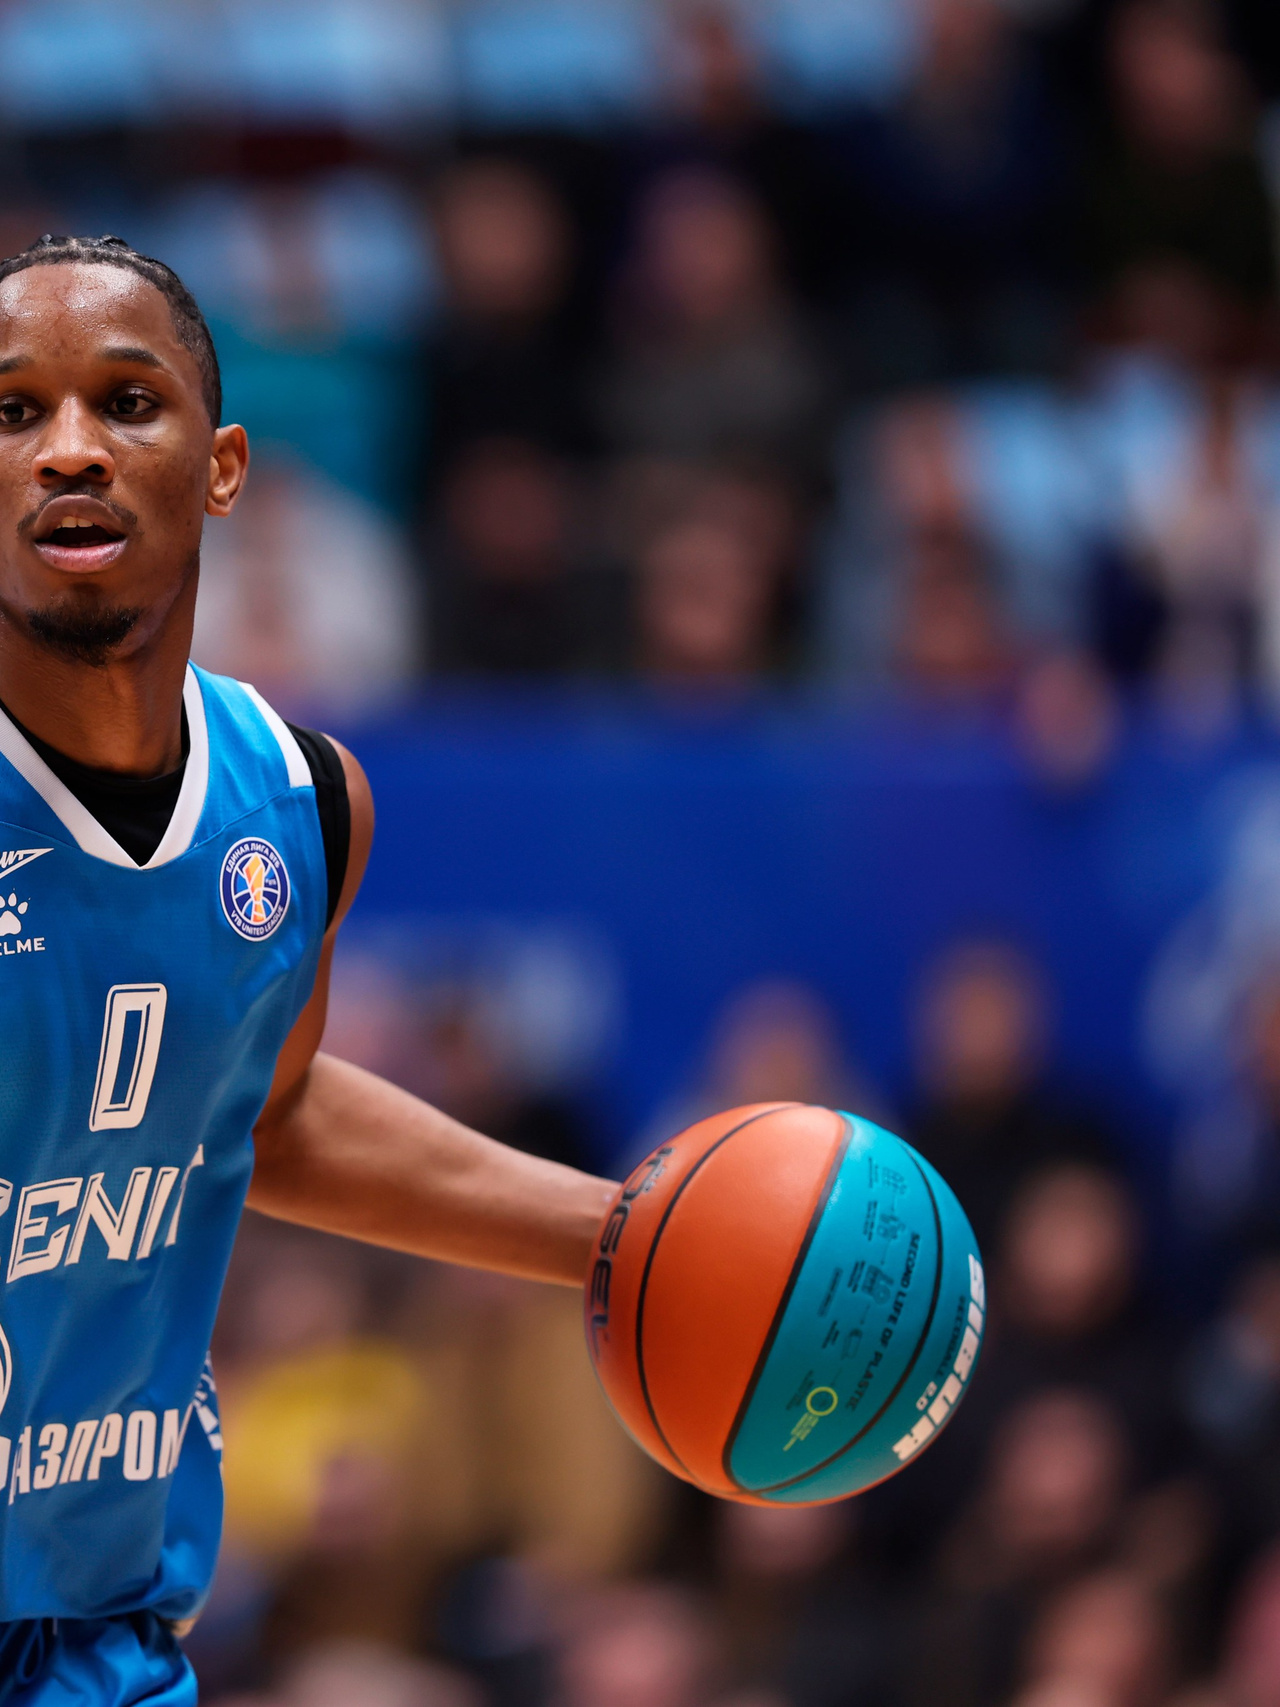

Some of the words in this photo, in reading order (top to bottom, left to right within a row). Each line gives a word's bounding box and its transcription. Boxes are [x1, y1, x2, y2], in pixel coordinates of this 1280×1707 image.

[225, 843, 250, 874] ЕДИНАЯ
[250, 843, 270, 857] ЛИГА
[231, 909, 241, 927] VTB
[241, 922, 265, 936] UNITED
[264, 904, 284, 932] LEAGUE
[89, 982, 168, 1132] 0
[900, 1232, 920, 1289] SECOND
[887, 1291, 908, 1325] LIFE
[880, 1327, 894, 1348] OF
[892, 1253, 985, 1461] SIBUR
[845, 1351, 884, 1412] PLASTIC
[916, 1381, 937, 1411] 2.0
